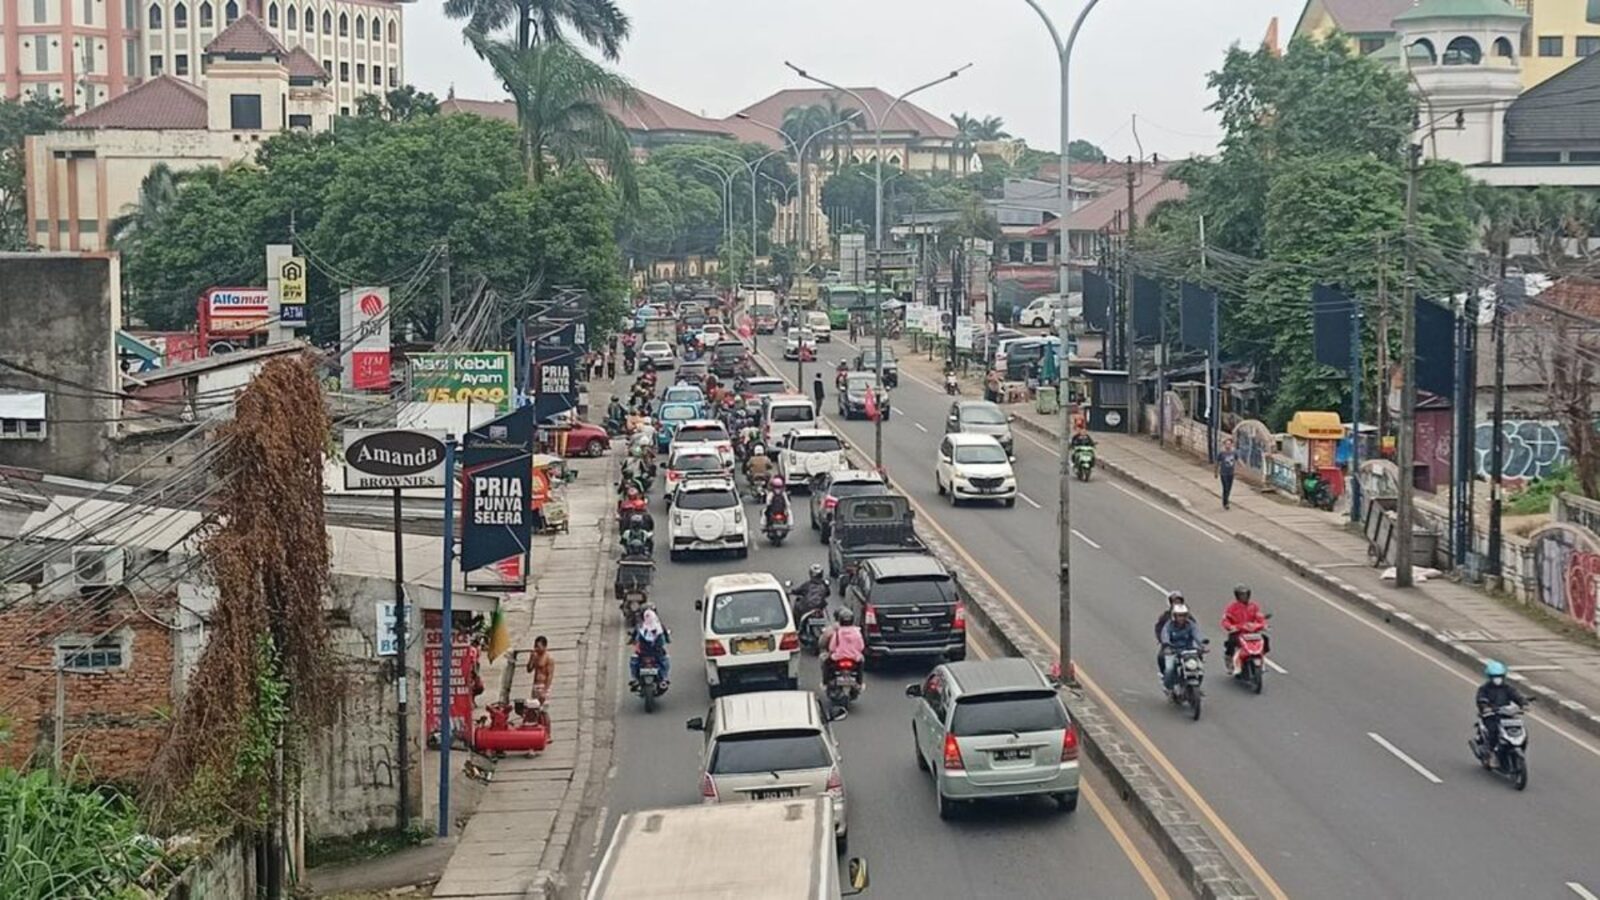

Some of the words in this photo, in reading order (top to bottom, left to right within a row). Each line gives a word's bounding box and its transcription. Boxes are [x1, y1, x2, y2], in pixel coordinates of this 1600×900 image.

[213, 294, 268, 304] Alfamar
[283, 290, 302, 298] BTN
[282, 306, 304, 318] ATM
[412, 357, 449, 371] Nasi
[454, 356, 505, 370] Kebuli
[541, 365, 570, 377] PRIA
[461, 373, 503, 385] Ayam
[357, 443, 438, 467] Amanda
[360, 476, 435, 487] BROWNIES
[475, 477, 523, 497] PRIA
[474, 496, 523, 511] PUNYA
[474, 511, 523, 525] SELERA
[427, 632, 469, 644] SEICE
